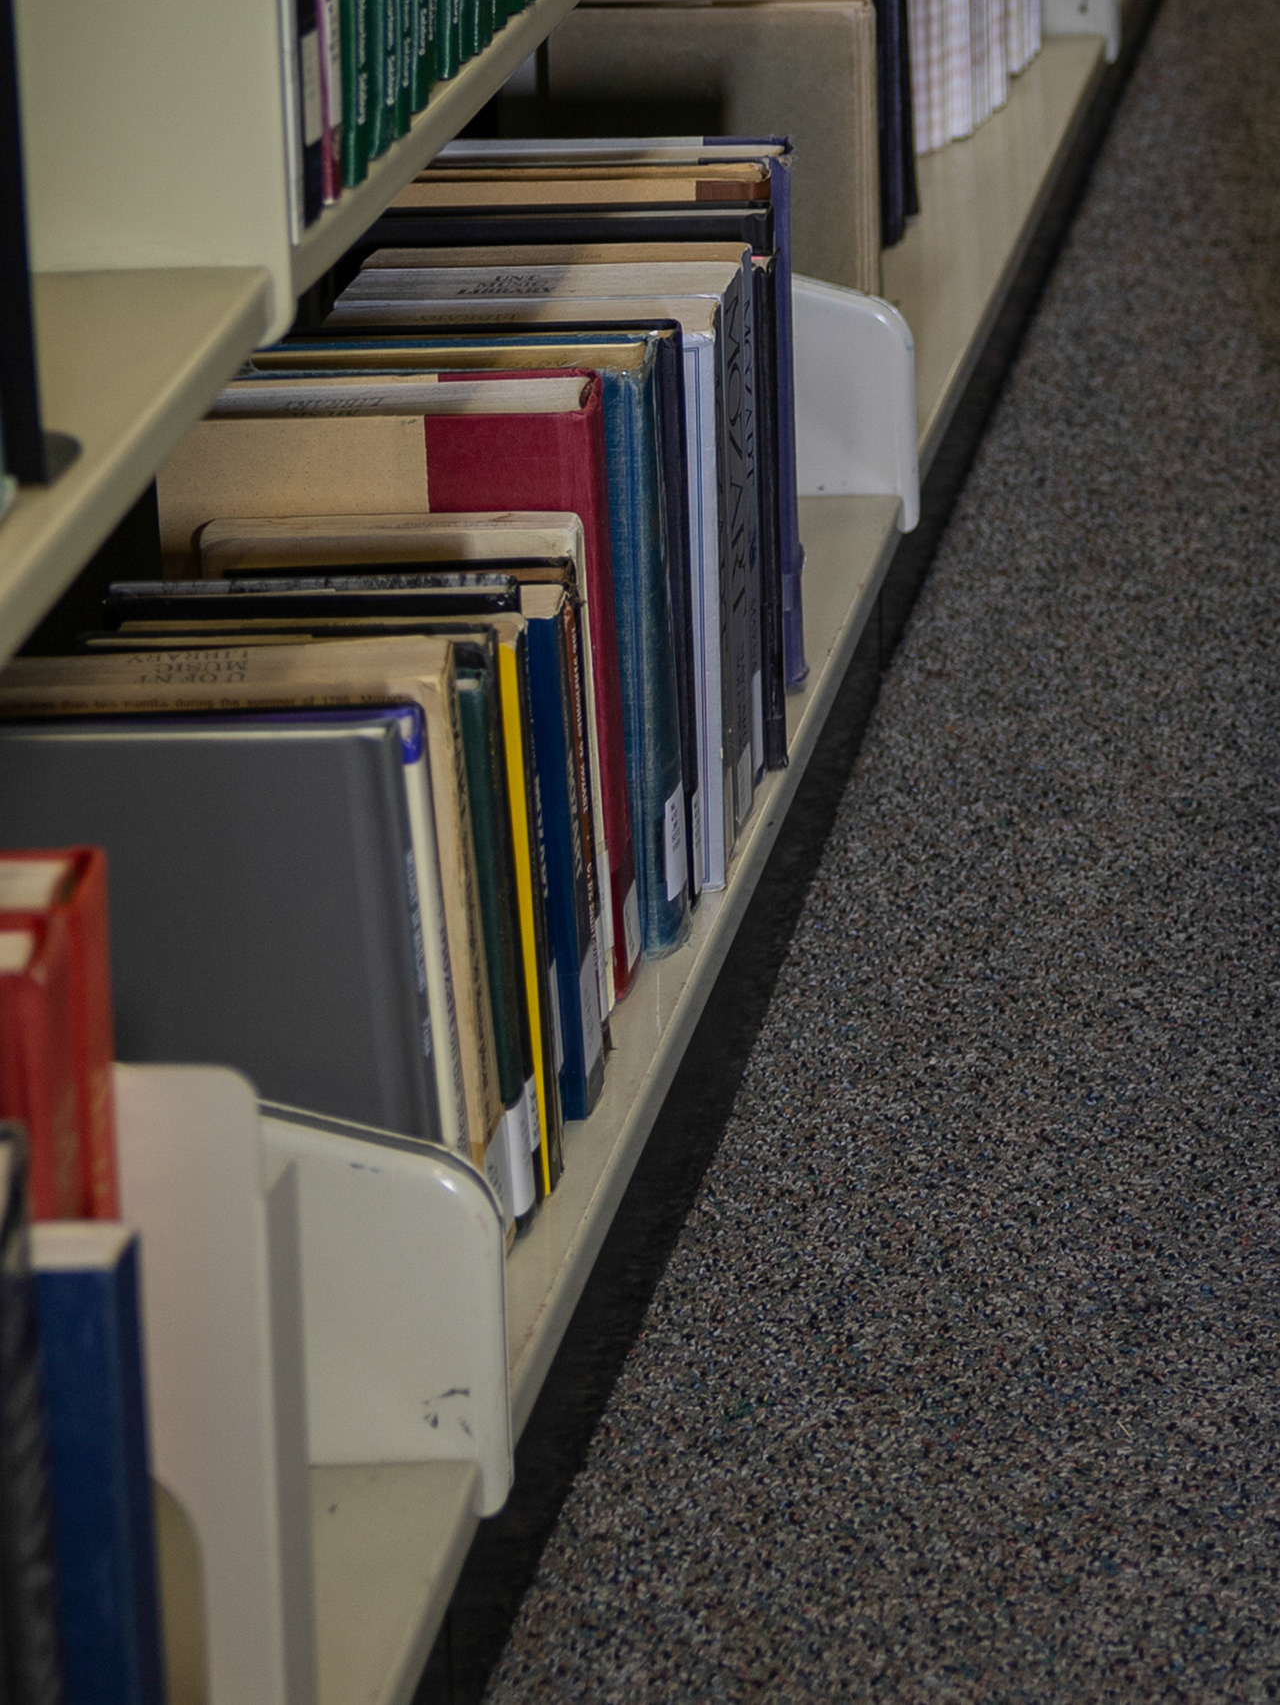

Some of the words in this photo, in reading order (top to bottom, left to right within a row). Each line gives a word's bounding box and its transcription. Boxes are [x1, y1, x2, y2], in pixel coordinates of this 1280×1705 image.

[724, 294, 747, 619] MOZART
[129, 650, 249, 663] LIBRARY
[156, 661, 247, 673] MUSIC
